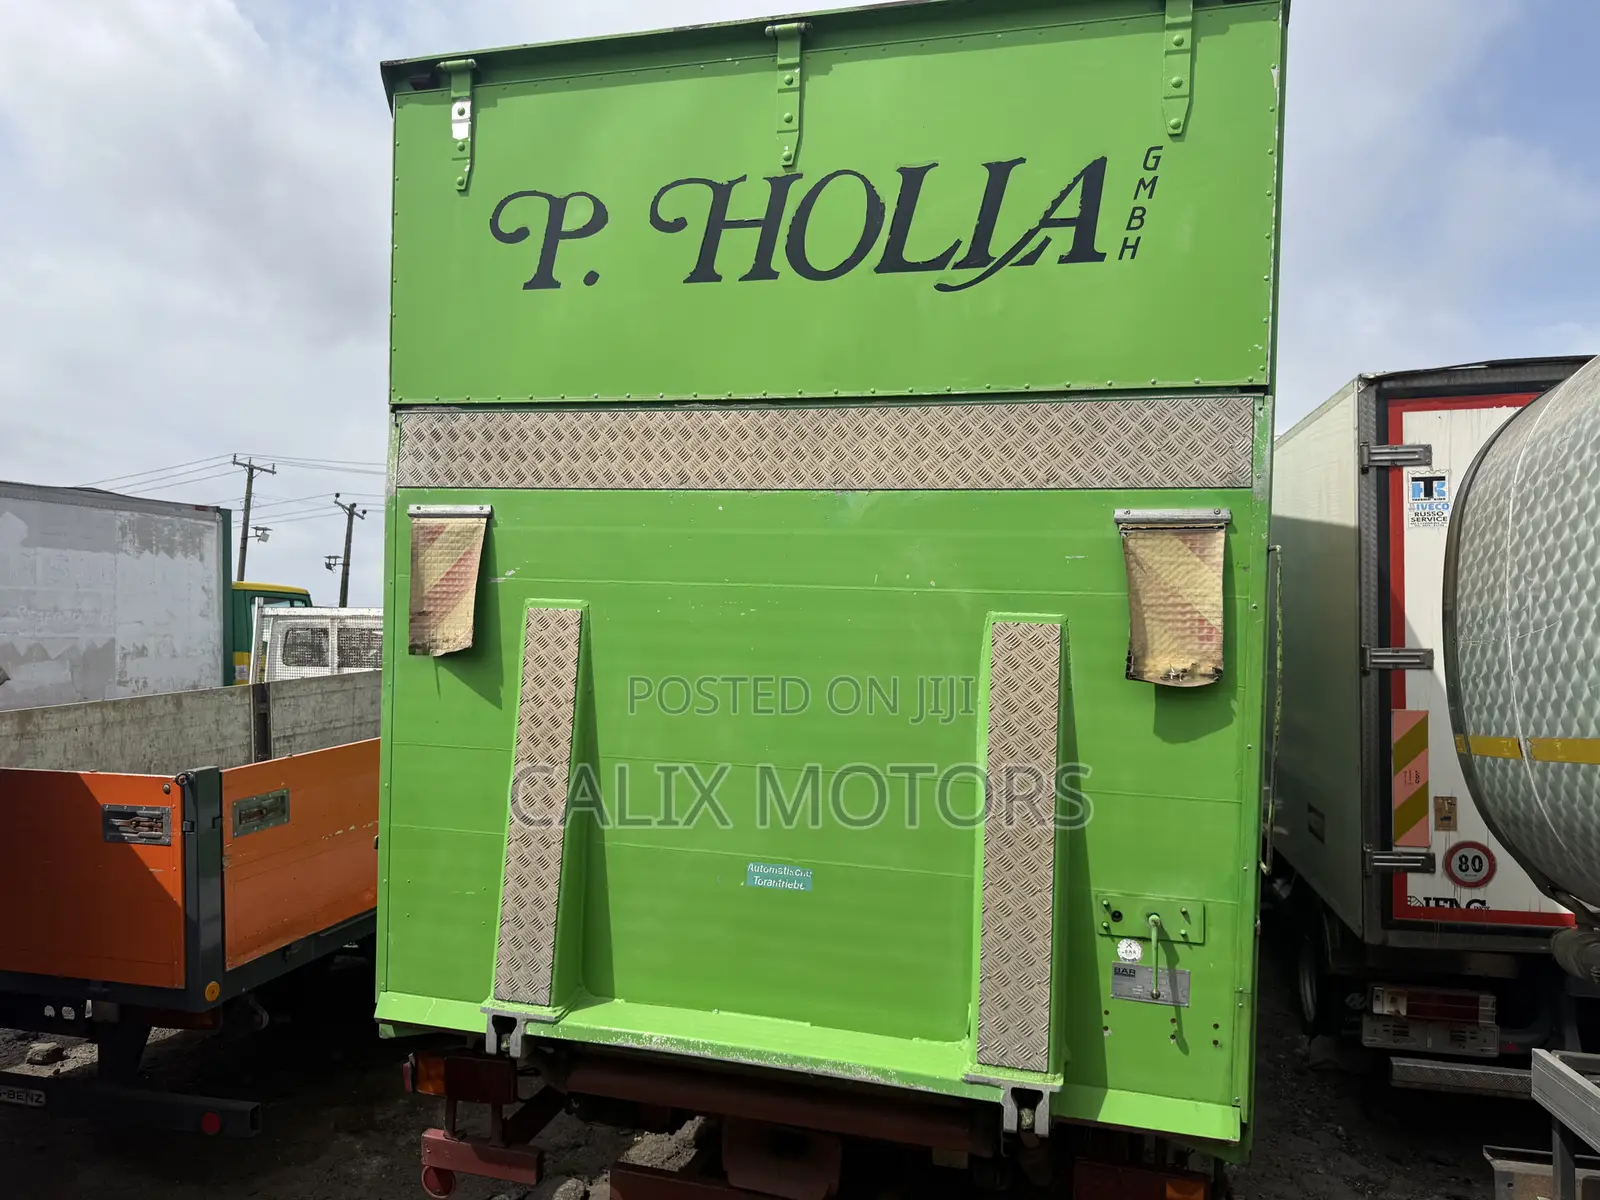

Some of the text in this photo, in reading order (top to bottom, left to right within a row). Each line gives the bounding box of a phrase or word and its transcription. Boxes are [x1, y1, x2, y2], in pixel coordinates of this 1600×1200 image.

[489, 189, 609, 290] P.
[1416, 503, 1450, 511] IVECO
[1458, 854, 1484, 873] 80
[1114, 966, 1137, 975] BAR
